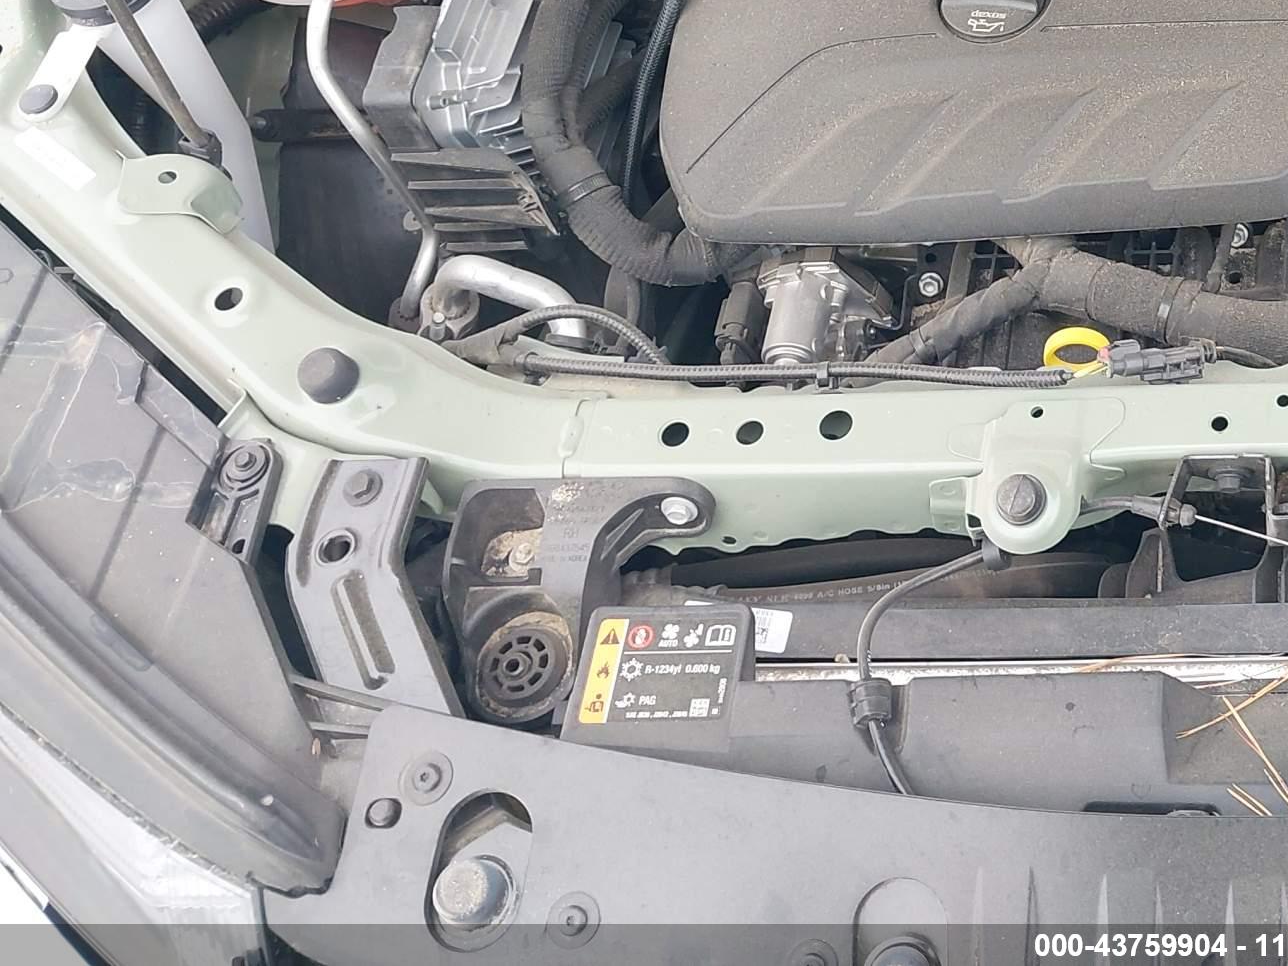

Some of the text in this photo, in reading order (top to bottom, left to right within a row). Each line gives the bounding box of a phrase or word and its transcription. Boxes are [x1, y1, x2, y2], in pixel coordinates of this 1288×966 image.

[971, 10, 1007, 19] dexos
[657, 639, 678, 648] AUTO
[639, 695, 657, 706] PAG
